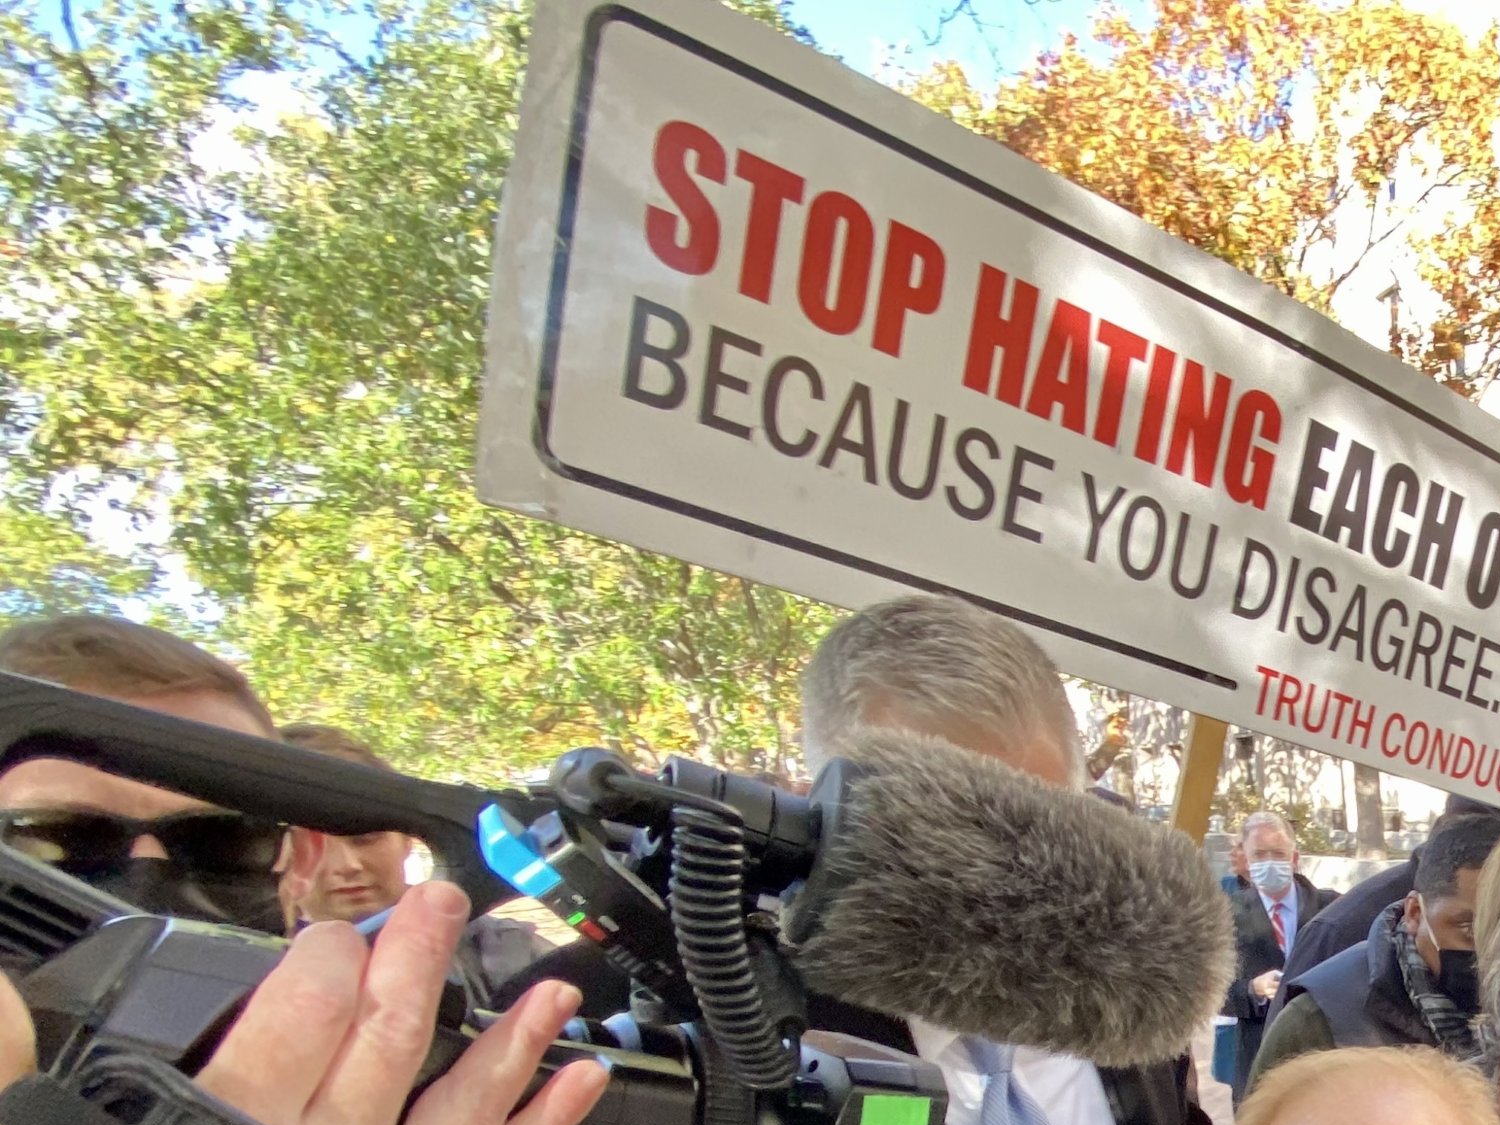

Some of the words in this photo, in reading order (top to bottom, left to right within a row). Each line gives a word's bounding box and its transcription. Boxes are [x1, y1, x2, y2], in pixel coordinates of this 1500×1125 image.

[621, 295, 1055, 544] BECAUSE
[1081, 470, 1219, 600] YOU
[645, 119, 946, 359] STOP
[962, 260, 1283, 511] HATING
[1289, 418, 1466, 591] EACH
[1254, 665, 1377, 750] TRUTH
